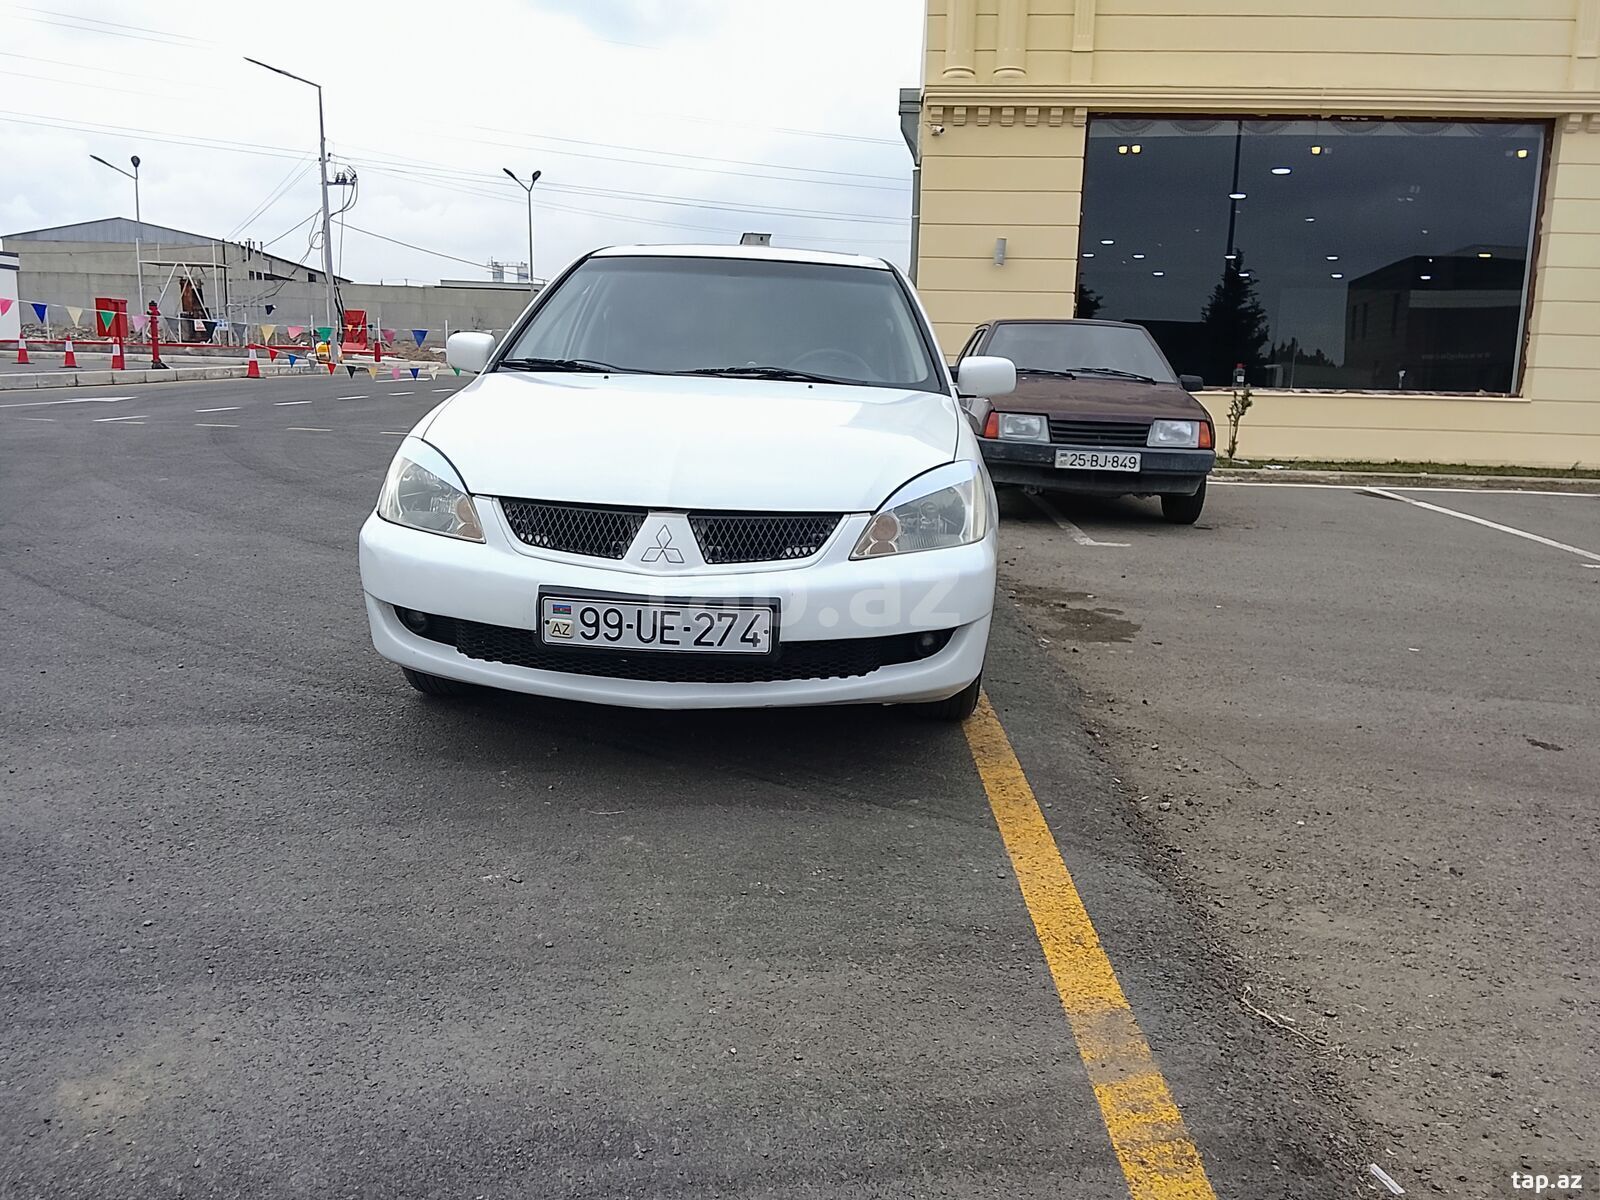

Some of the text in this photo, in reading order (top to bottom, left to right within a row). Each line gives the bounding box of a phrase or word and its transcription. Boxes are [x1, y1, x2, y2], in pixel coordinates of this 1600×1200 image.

[1069, 453, 1137, 469] 25-BJ-849
[551, 622, 571, 637] AZ
[579, 606, 762, 648] 99-UE-274
